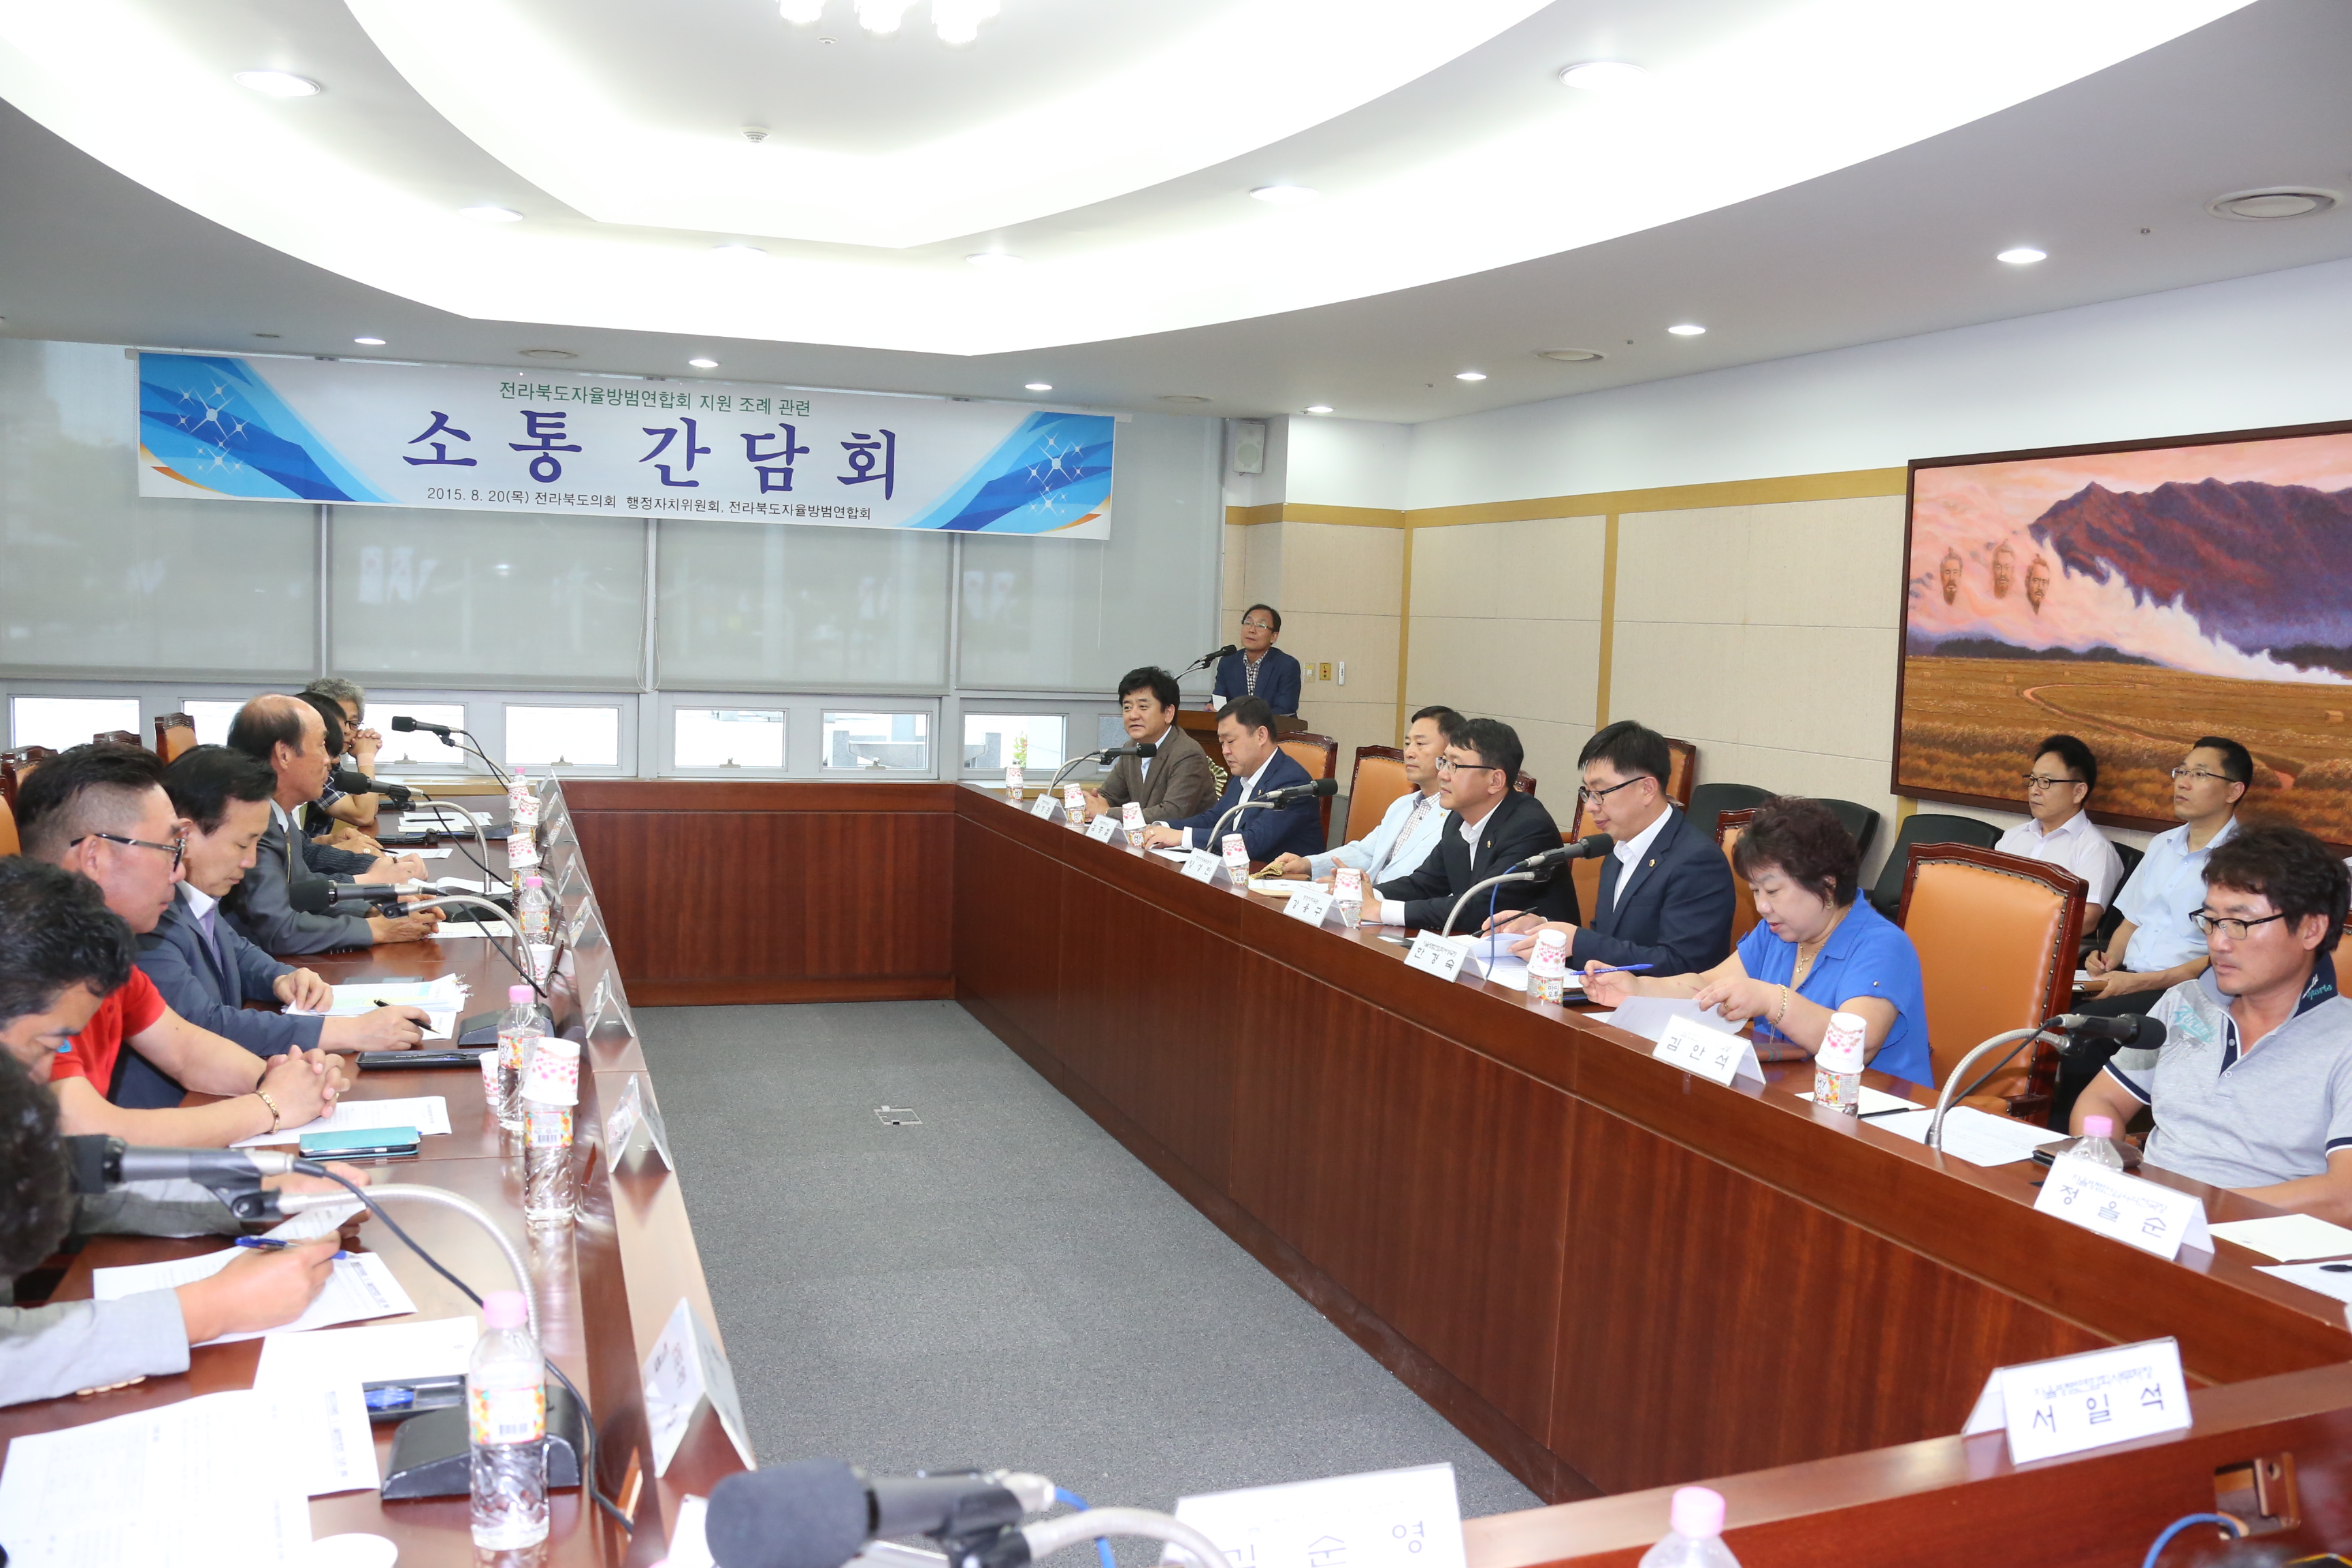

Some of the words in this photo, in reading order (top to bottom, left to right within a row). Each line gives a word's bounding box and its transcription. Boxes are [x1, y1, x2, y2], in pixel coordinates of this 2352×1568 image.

[499, 381, 691, 410] 전라북도자율방범연합회
[700, 393, 732, 412] 지원
[739, 397, 771, 415] 조례
[779, 399, 810, 417] 관련
[402, 410, 583, 483] 소통
[638, 416, 897, 502] 간담회
[427, 487, 466, 501] 2015.
[470, 489, 483, 502] 8.
[488, 490, 529, 504] 20(목)
[534, 491, 616, 508] 전라북도의회
[626, 495, 724, 513] 행정자치위원회,
[728, 500, 872, 520] 전라북도자율방범연합회
[1292, 899, 1323, 917] 강용구
[1414, 947, 1455, 972] 한경숙
[500, 1043, 510, 1054] MY
[1666, 1036, 1730, 1071] 김안석
[2059, 1184, 2167, 1239] 정을순
[2032, 1382, 2165, 1433] 서일석
